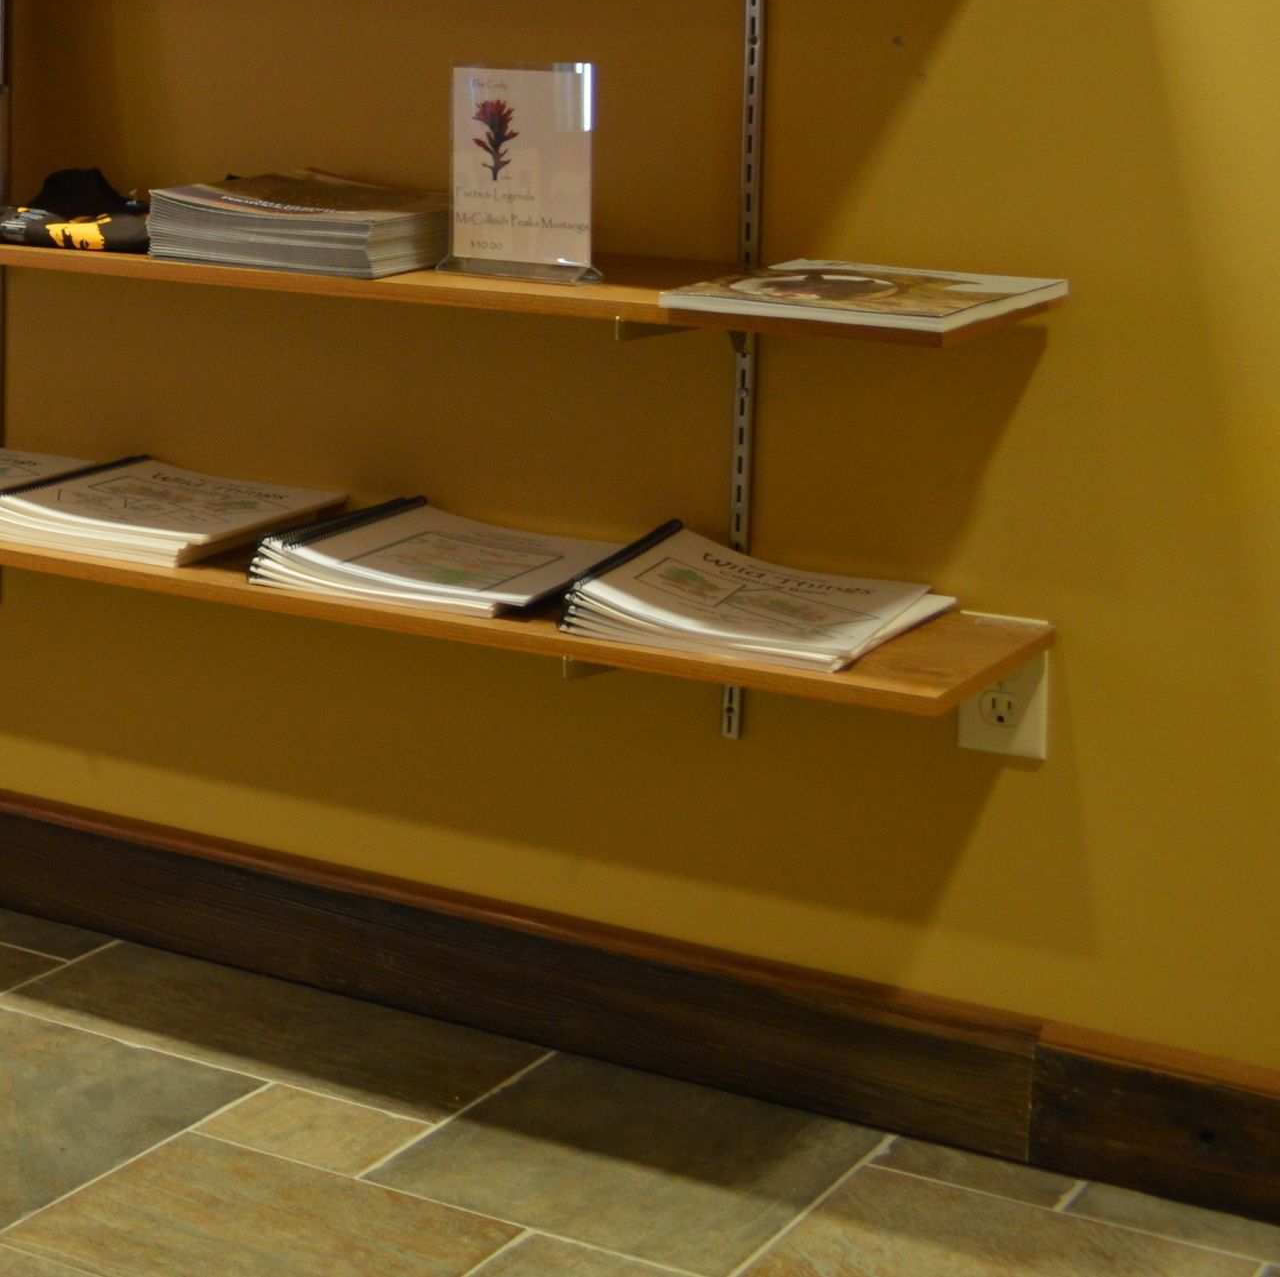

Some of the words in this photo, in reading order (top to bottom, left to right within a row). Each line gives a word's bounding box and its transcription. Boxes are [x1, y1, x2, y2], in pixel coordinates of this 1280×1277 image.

[152, 470, 206, 489] Wild
[702, 550, 772, 581] Wild
[768, 574, 876, 600] Things
